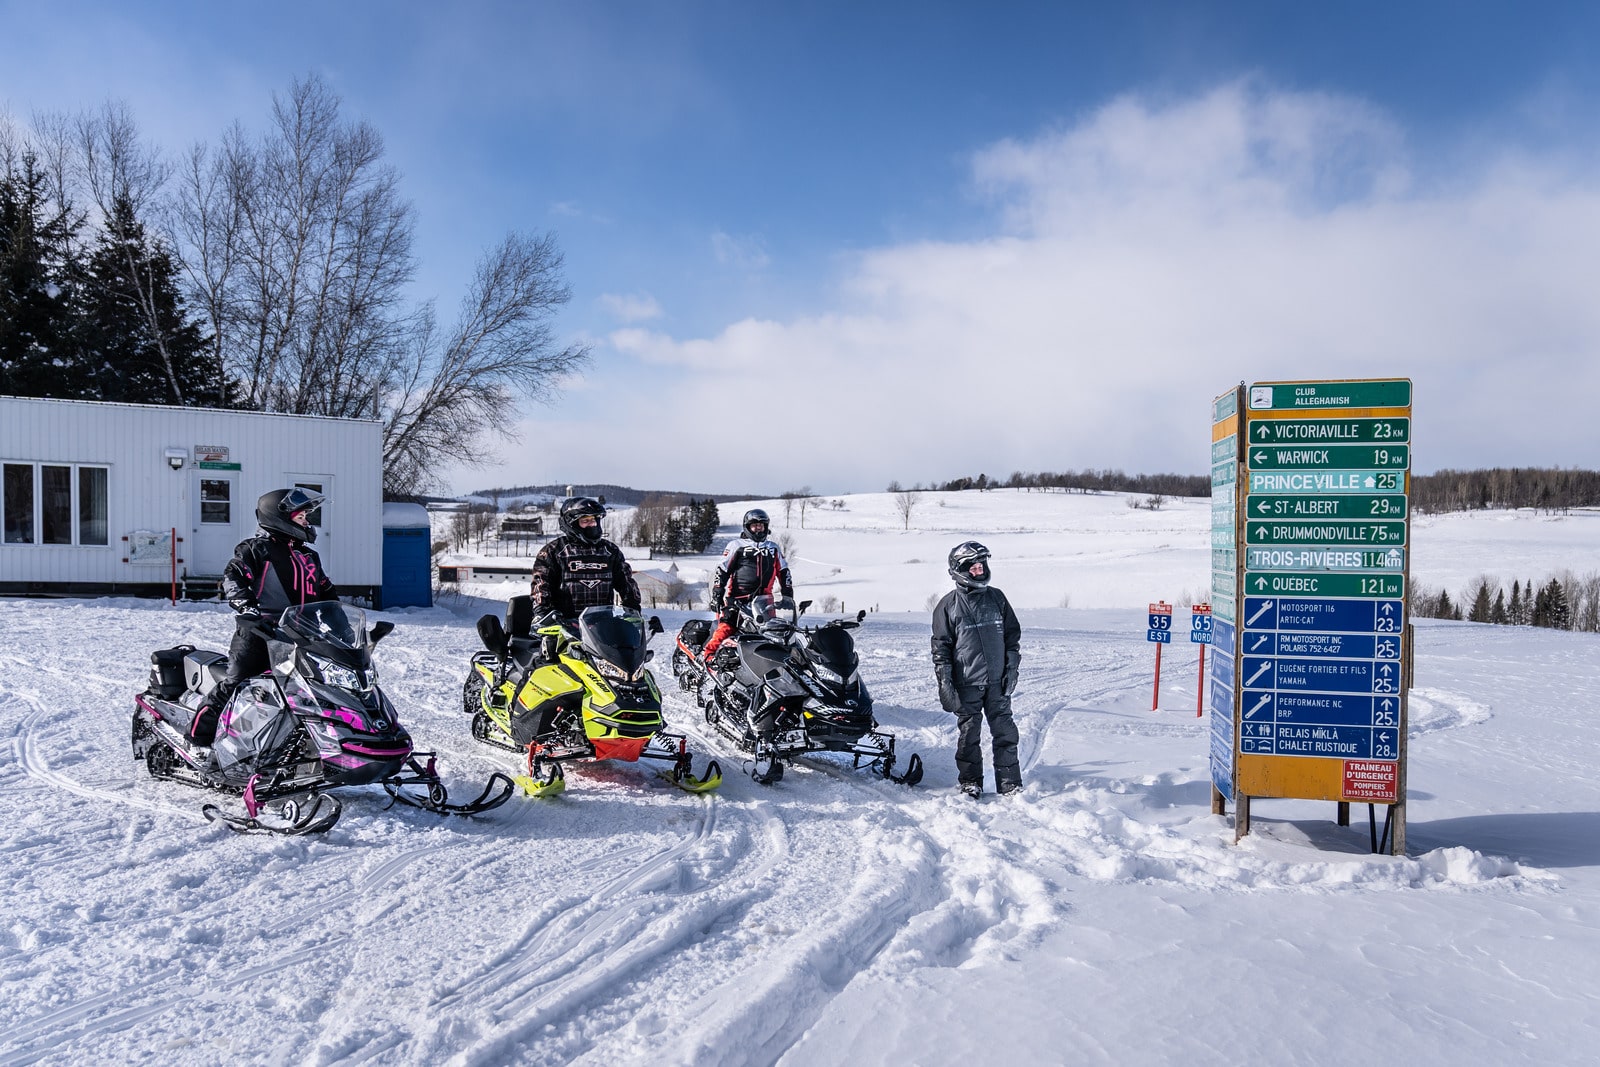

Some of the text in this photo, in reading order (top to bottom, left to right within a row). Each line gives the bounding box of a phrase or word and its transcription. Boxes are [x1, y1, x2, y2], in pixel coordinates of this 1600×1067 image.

[1296, 388, 1315, 396] CLUB
[1295, 397, 1349, 405] ALLEGHANISH
[1275, 424, 1403, 438] VICTORIAVILLE 23 KM
[1277, 450, 1402, 465] WARWICK 19 KM
[1254, 474, 1396, 490] PRINCEVILLE 25
[1275, 500, 1400, 514] ST-ALBERT 29 KM
[1273, 527, 1366, 540] DRUMMONDVILLE
[1370, 526, 1387, 540] 75
[1363, 553, 1384, 567] 114
[1273, 576, 1318, 591] QUÉBEC
[1361, 579, 1384, 594] 121
[1281, 604, 1322, 612] MOTOSPORT
[1153, 616, 1167, 629] 35
[1195, 616, 1210, 630] 65
[1377, 618, 1393, 632] 23
[1150, 632, 1167, 641] EST
[1193, 632, 1211, 642] NORD
[1378, 644, 1394, 658] 25
[1309, 666, 1337, 674] FORTIER
[1375, 679, 1391, 692] 25
[1280, 698, 1330, 707] PERFORMANCE
[1376, 712, 1392, 726] 25
[1280, 728, 1309, 738] RELAIS
[1279, 740, 1358, 753] CHALET RUSTIQUE
[1376, 745, 1390, 757] 28
[1347, 772, 1394, 780] D'URGENCE
